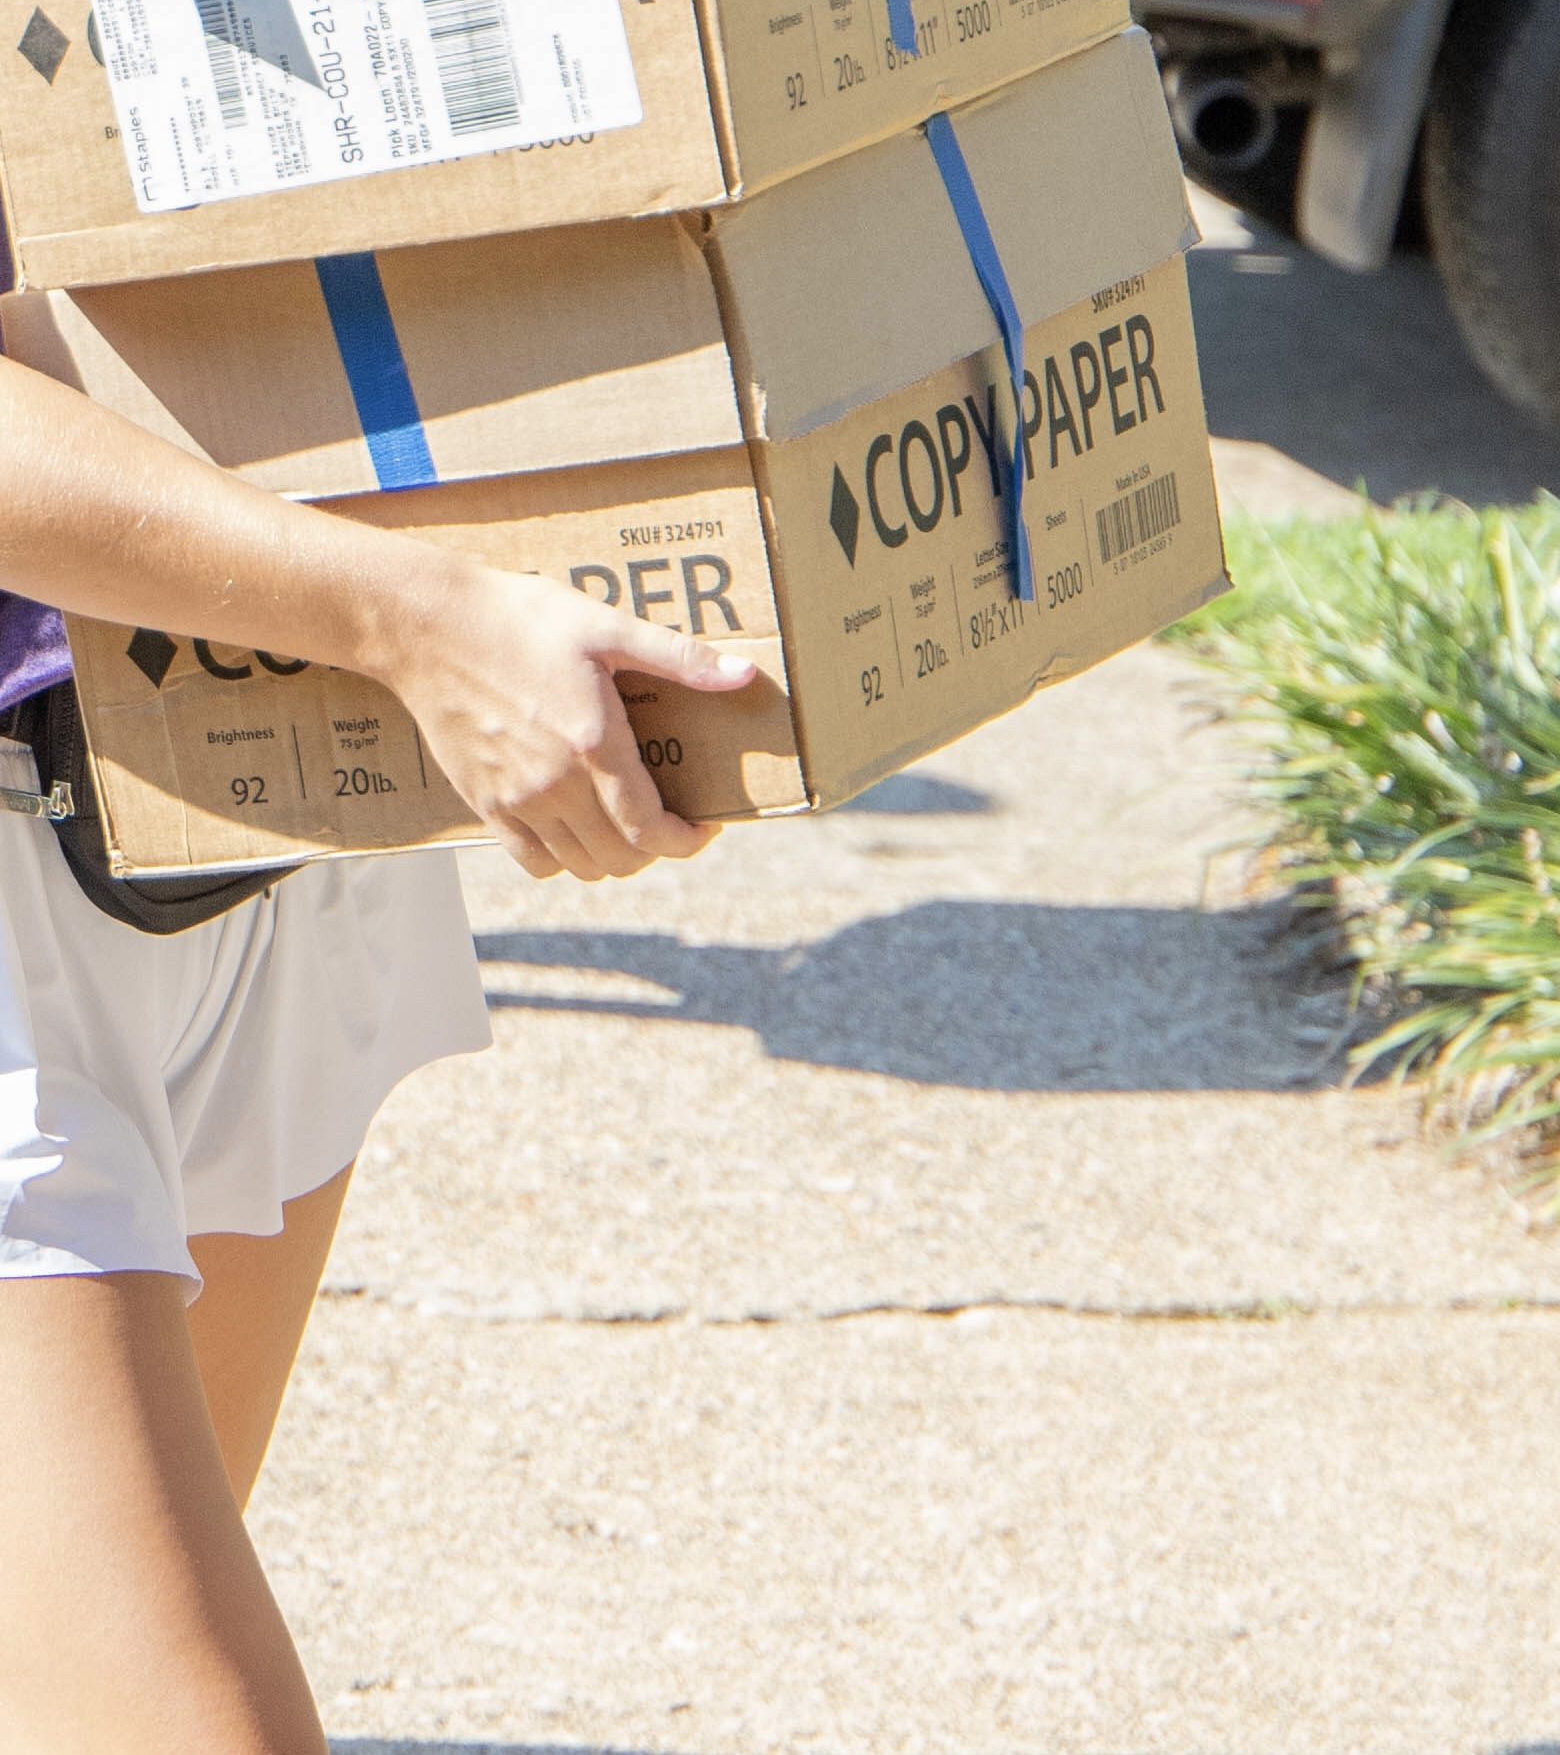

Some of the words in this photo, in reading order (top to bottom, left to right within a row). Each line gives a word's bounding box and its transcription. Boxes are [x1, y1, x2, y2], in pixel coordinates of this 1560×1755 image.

[376, 1, 393, 30] COPY
[955, 0, 992, 45] 5000
[786, 72, 808, 112] 92
[127, 105, 152, 173] Staples
[385, 127, 405, 158] Pick
[865, 383, 1003, 549] COPY
[1010, 313, 1166, 481] PAPER
[664, 520, 725, 542] 324791
[1045, 510, 1068, 532] Sheets
[570, 553, 744, 635] PER
[1046, 562, 1083, 609] 5000
[621, 691, 658, 704] heets
[860, 666, 884, 706] 92
[206, 726, 275, 746] Brightness
[332, 716, 381, 739] Weight
[637, 737, 684, 768] 00
[230, 776, 269, 806] 92
